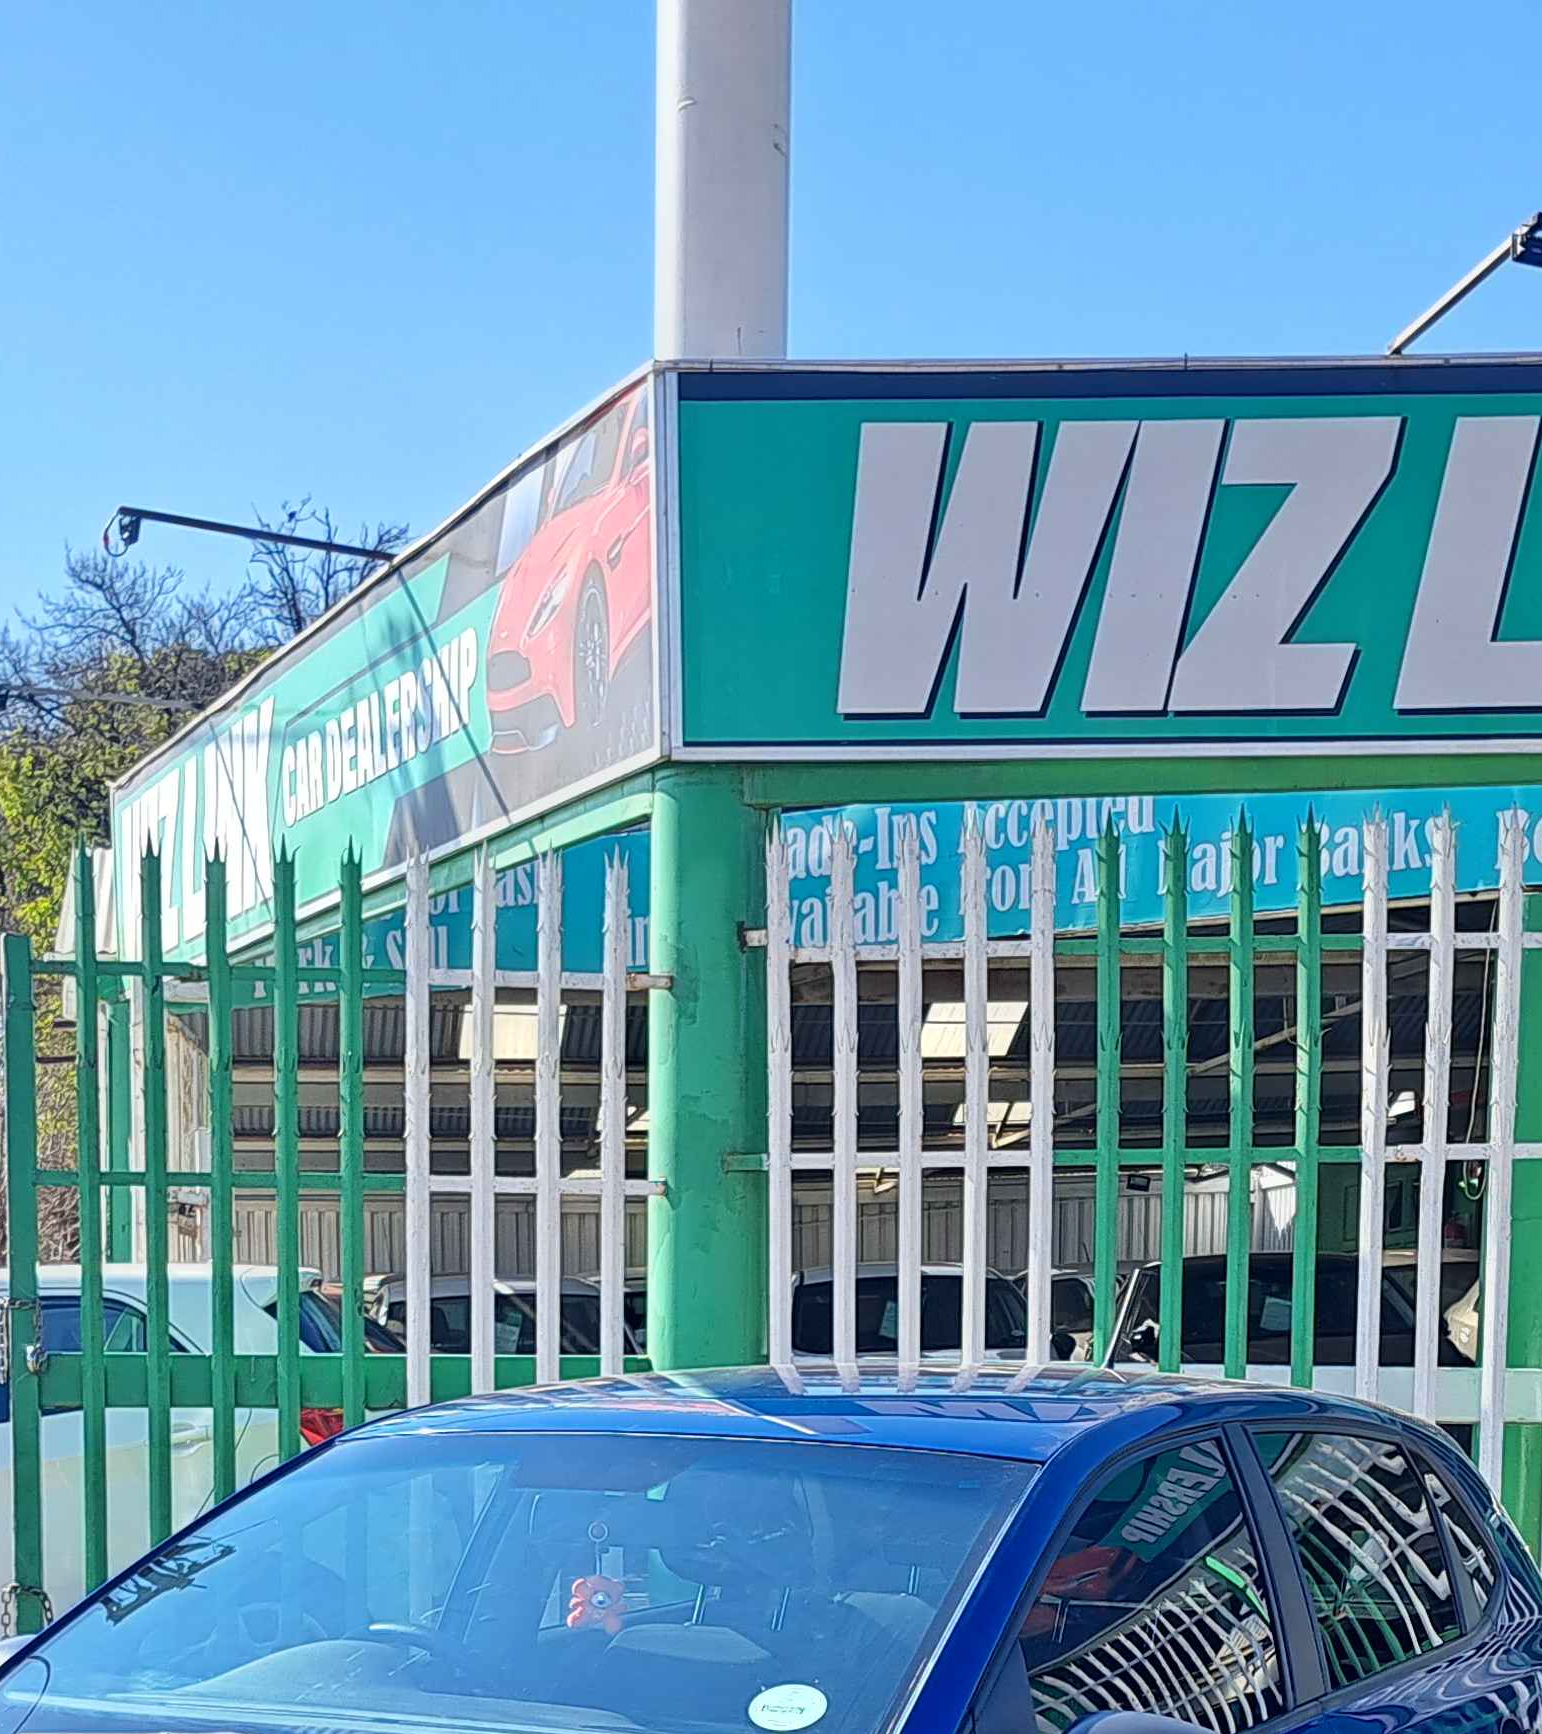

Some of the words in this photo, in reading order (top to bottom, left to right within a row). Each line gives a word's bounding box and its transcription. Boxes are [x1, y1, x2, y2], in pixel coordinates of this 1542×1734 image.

[837, 416, 1407, 719] WIZ
[282, 730, 325, 829] CAR
[325, 627, 479, 802] DEALERSHIP
